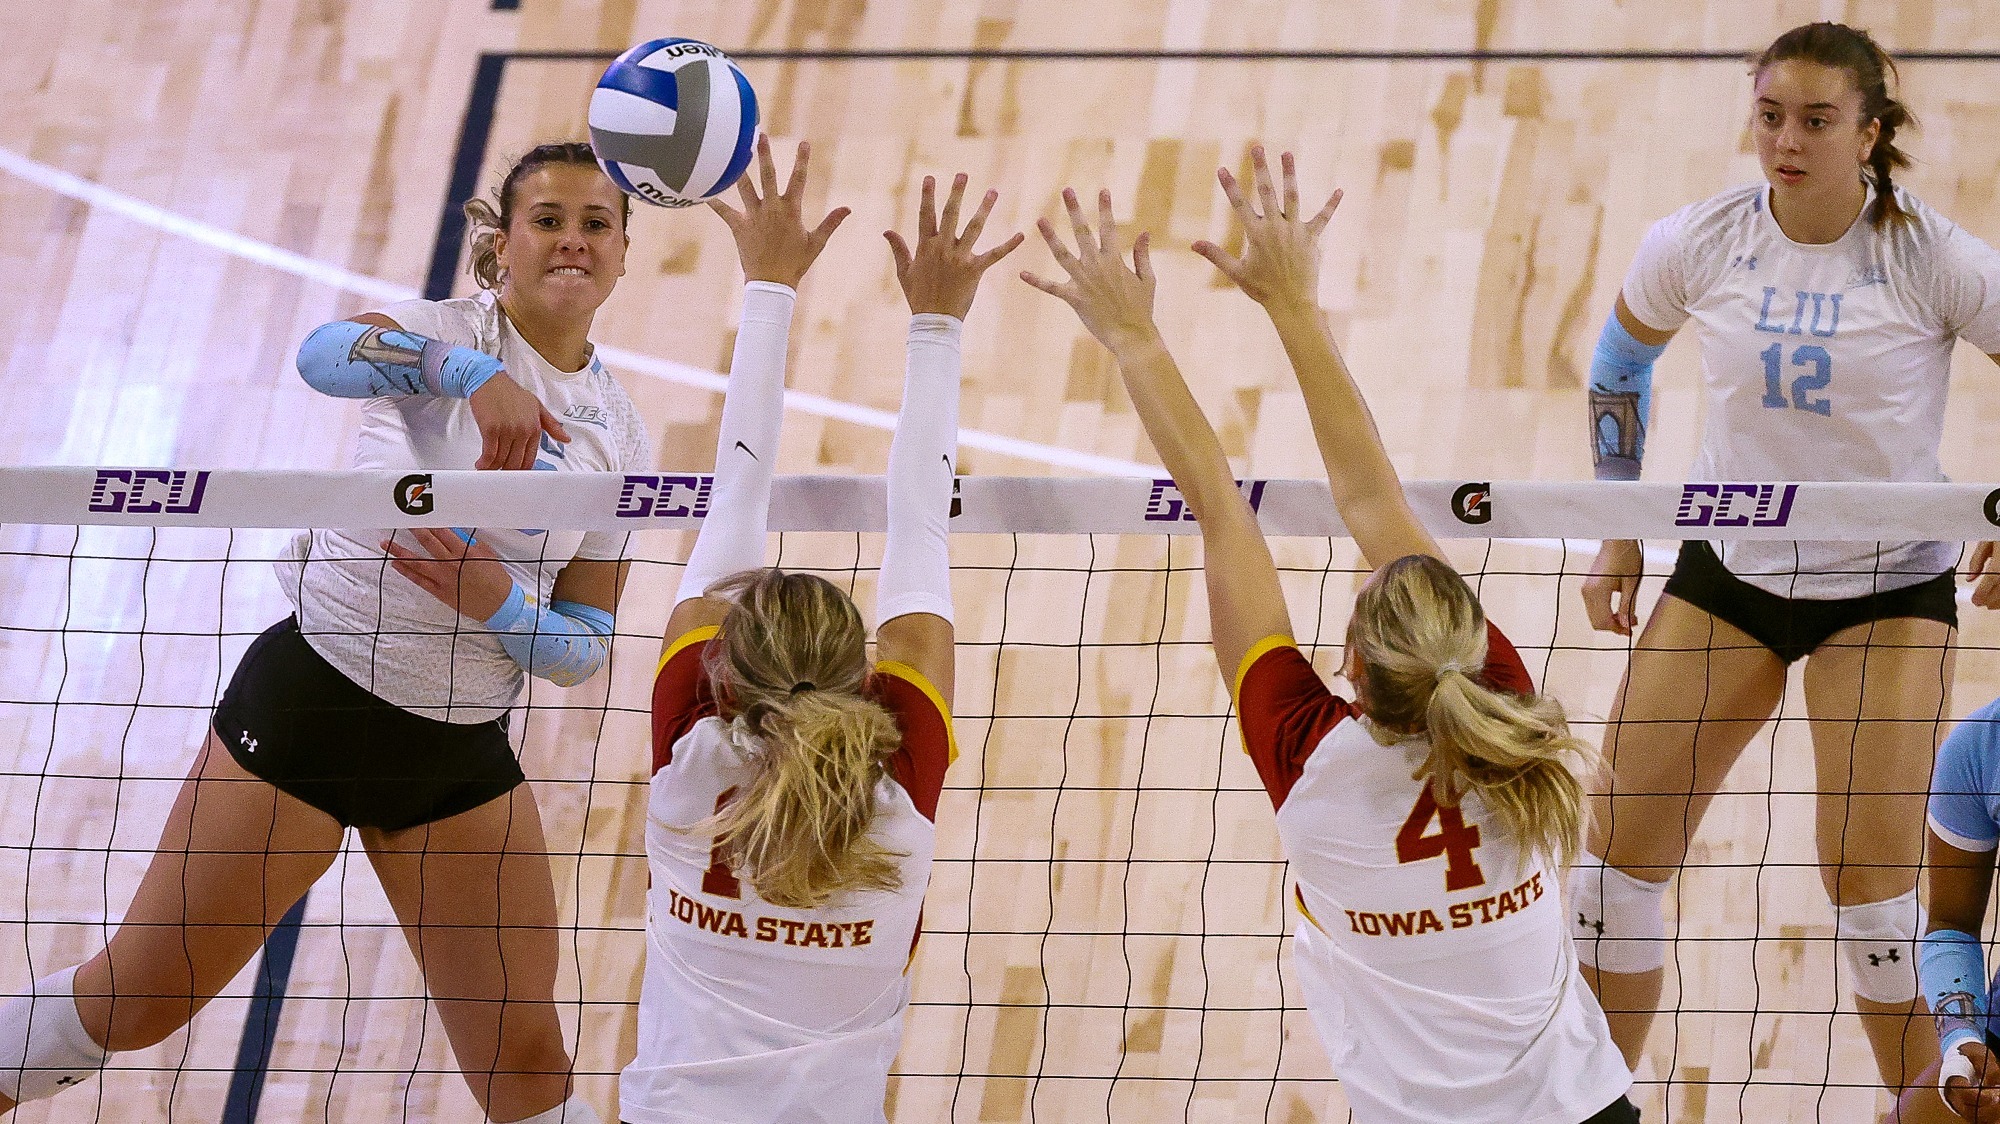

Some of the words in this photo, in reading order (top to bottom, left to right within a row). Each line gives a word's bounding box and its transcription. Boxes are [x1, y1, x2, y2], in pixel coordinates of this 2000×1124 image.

[666, 44, 728, 58] lten
[1754, 286, 1844, 337] LIU
[1760, 342, 1831, 417] 12
[88, 469, 212, 514] GCU
[393, 473, 435, 515] G
[1451, 482, 1492, 525] G
[1675, 484, 1800, 527] GCU
[1395, 775, 1485, 893] 4
[669, 888, 748, 939] IOWA
[755, 916, 875, 949] STATE
[1344, 909, 1444, 936] IOWA
[1448, 871, 1544, 929] STATE
